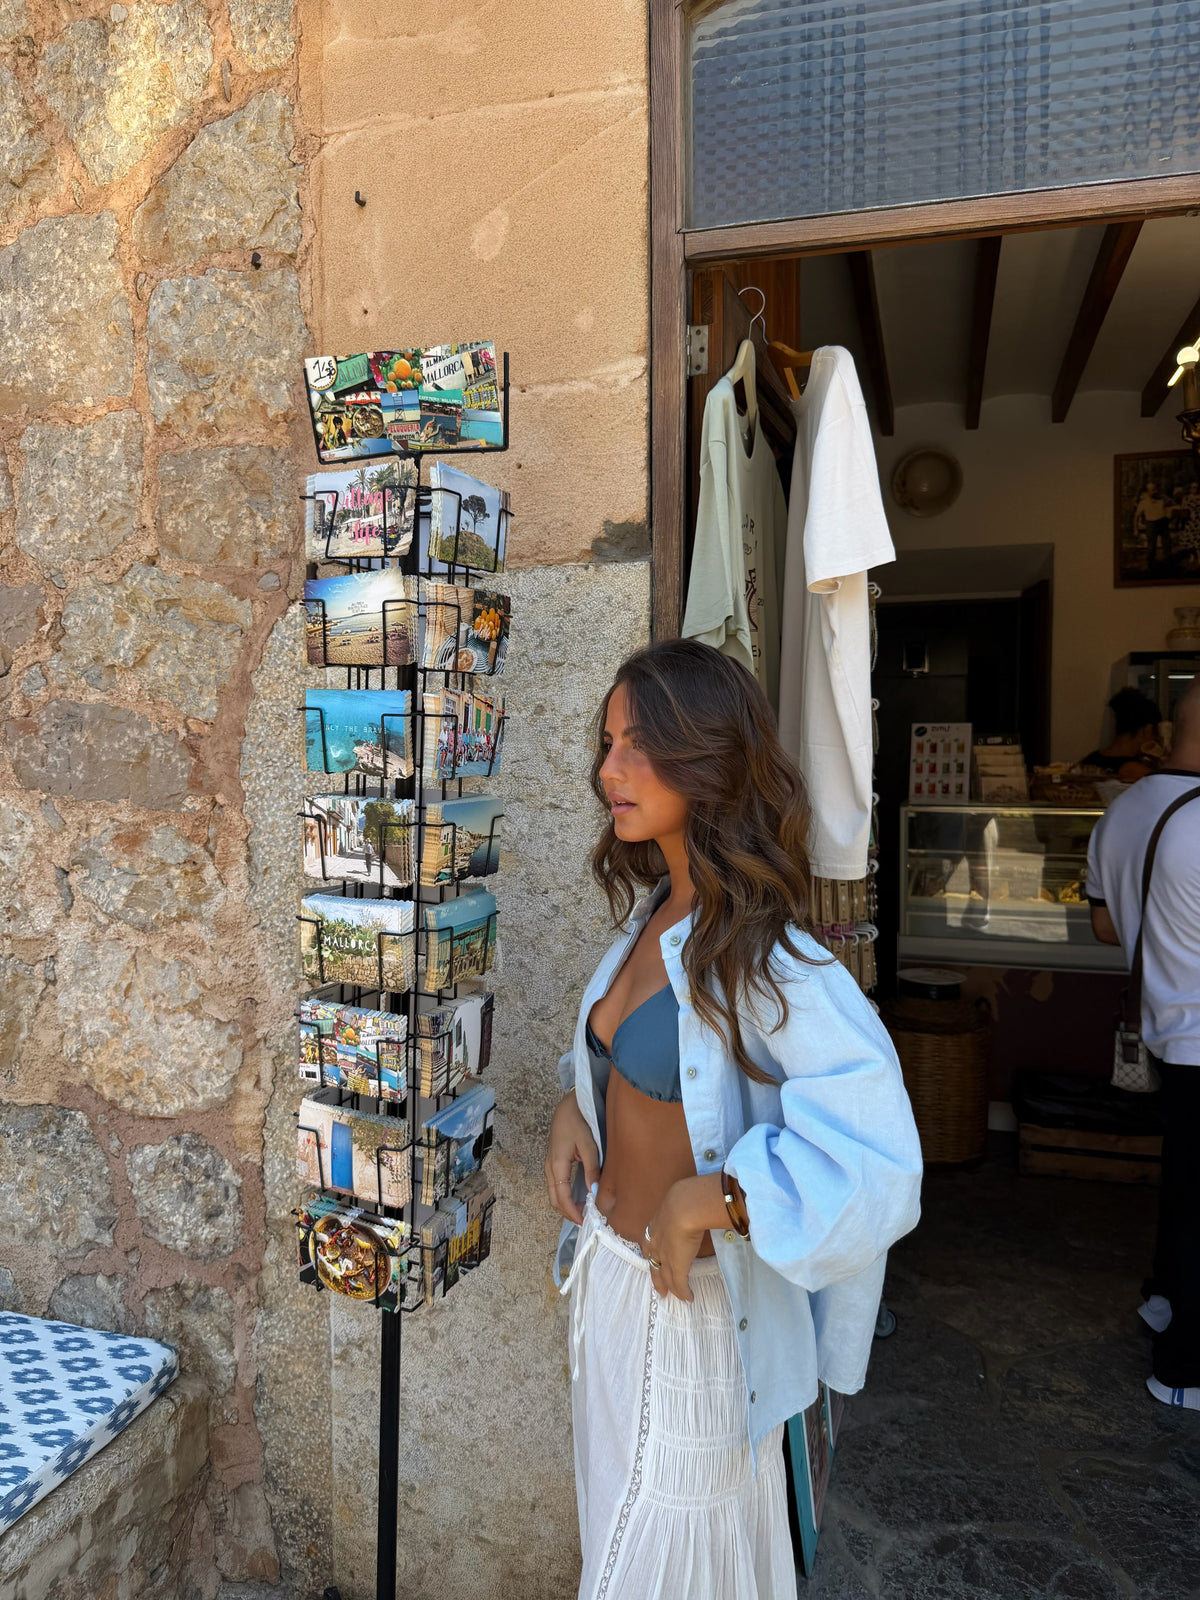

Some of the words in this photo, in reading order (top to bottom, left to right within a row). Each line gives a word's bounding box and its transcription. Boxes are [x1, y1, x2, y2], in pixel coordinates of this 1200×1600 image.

[423, 360, 465, 384] MALLORCA
[346, 391, 381, 402] BAR
[327, 487, 395, 514] Village
[348, 520, 384, 546] Life
[323, 935, 378, 952] MALLORCA
[447, 1218, 480, 1267] OLLER
